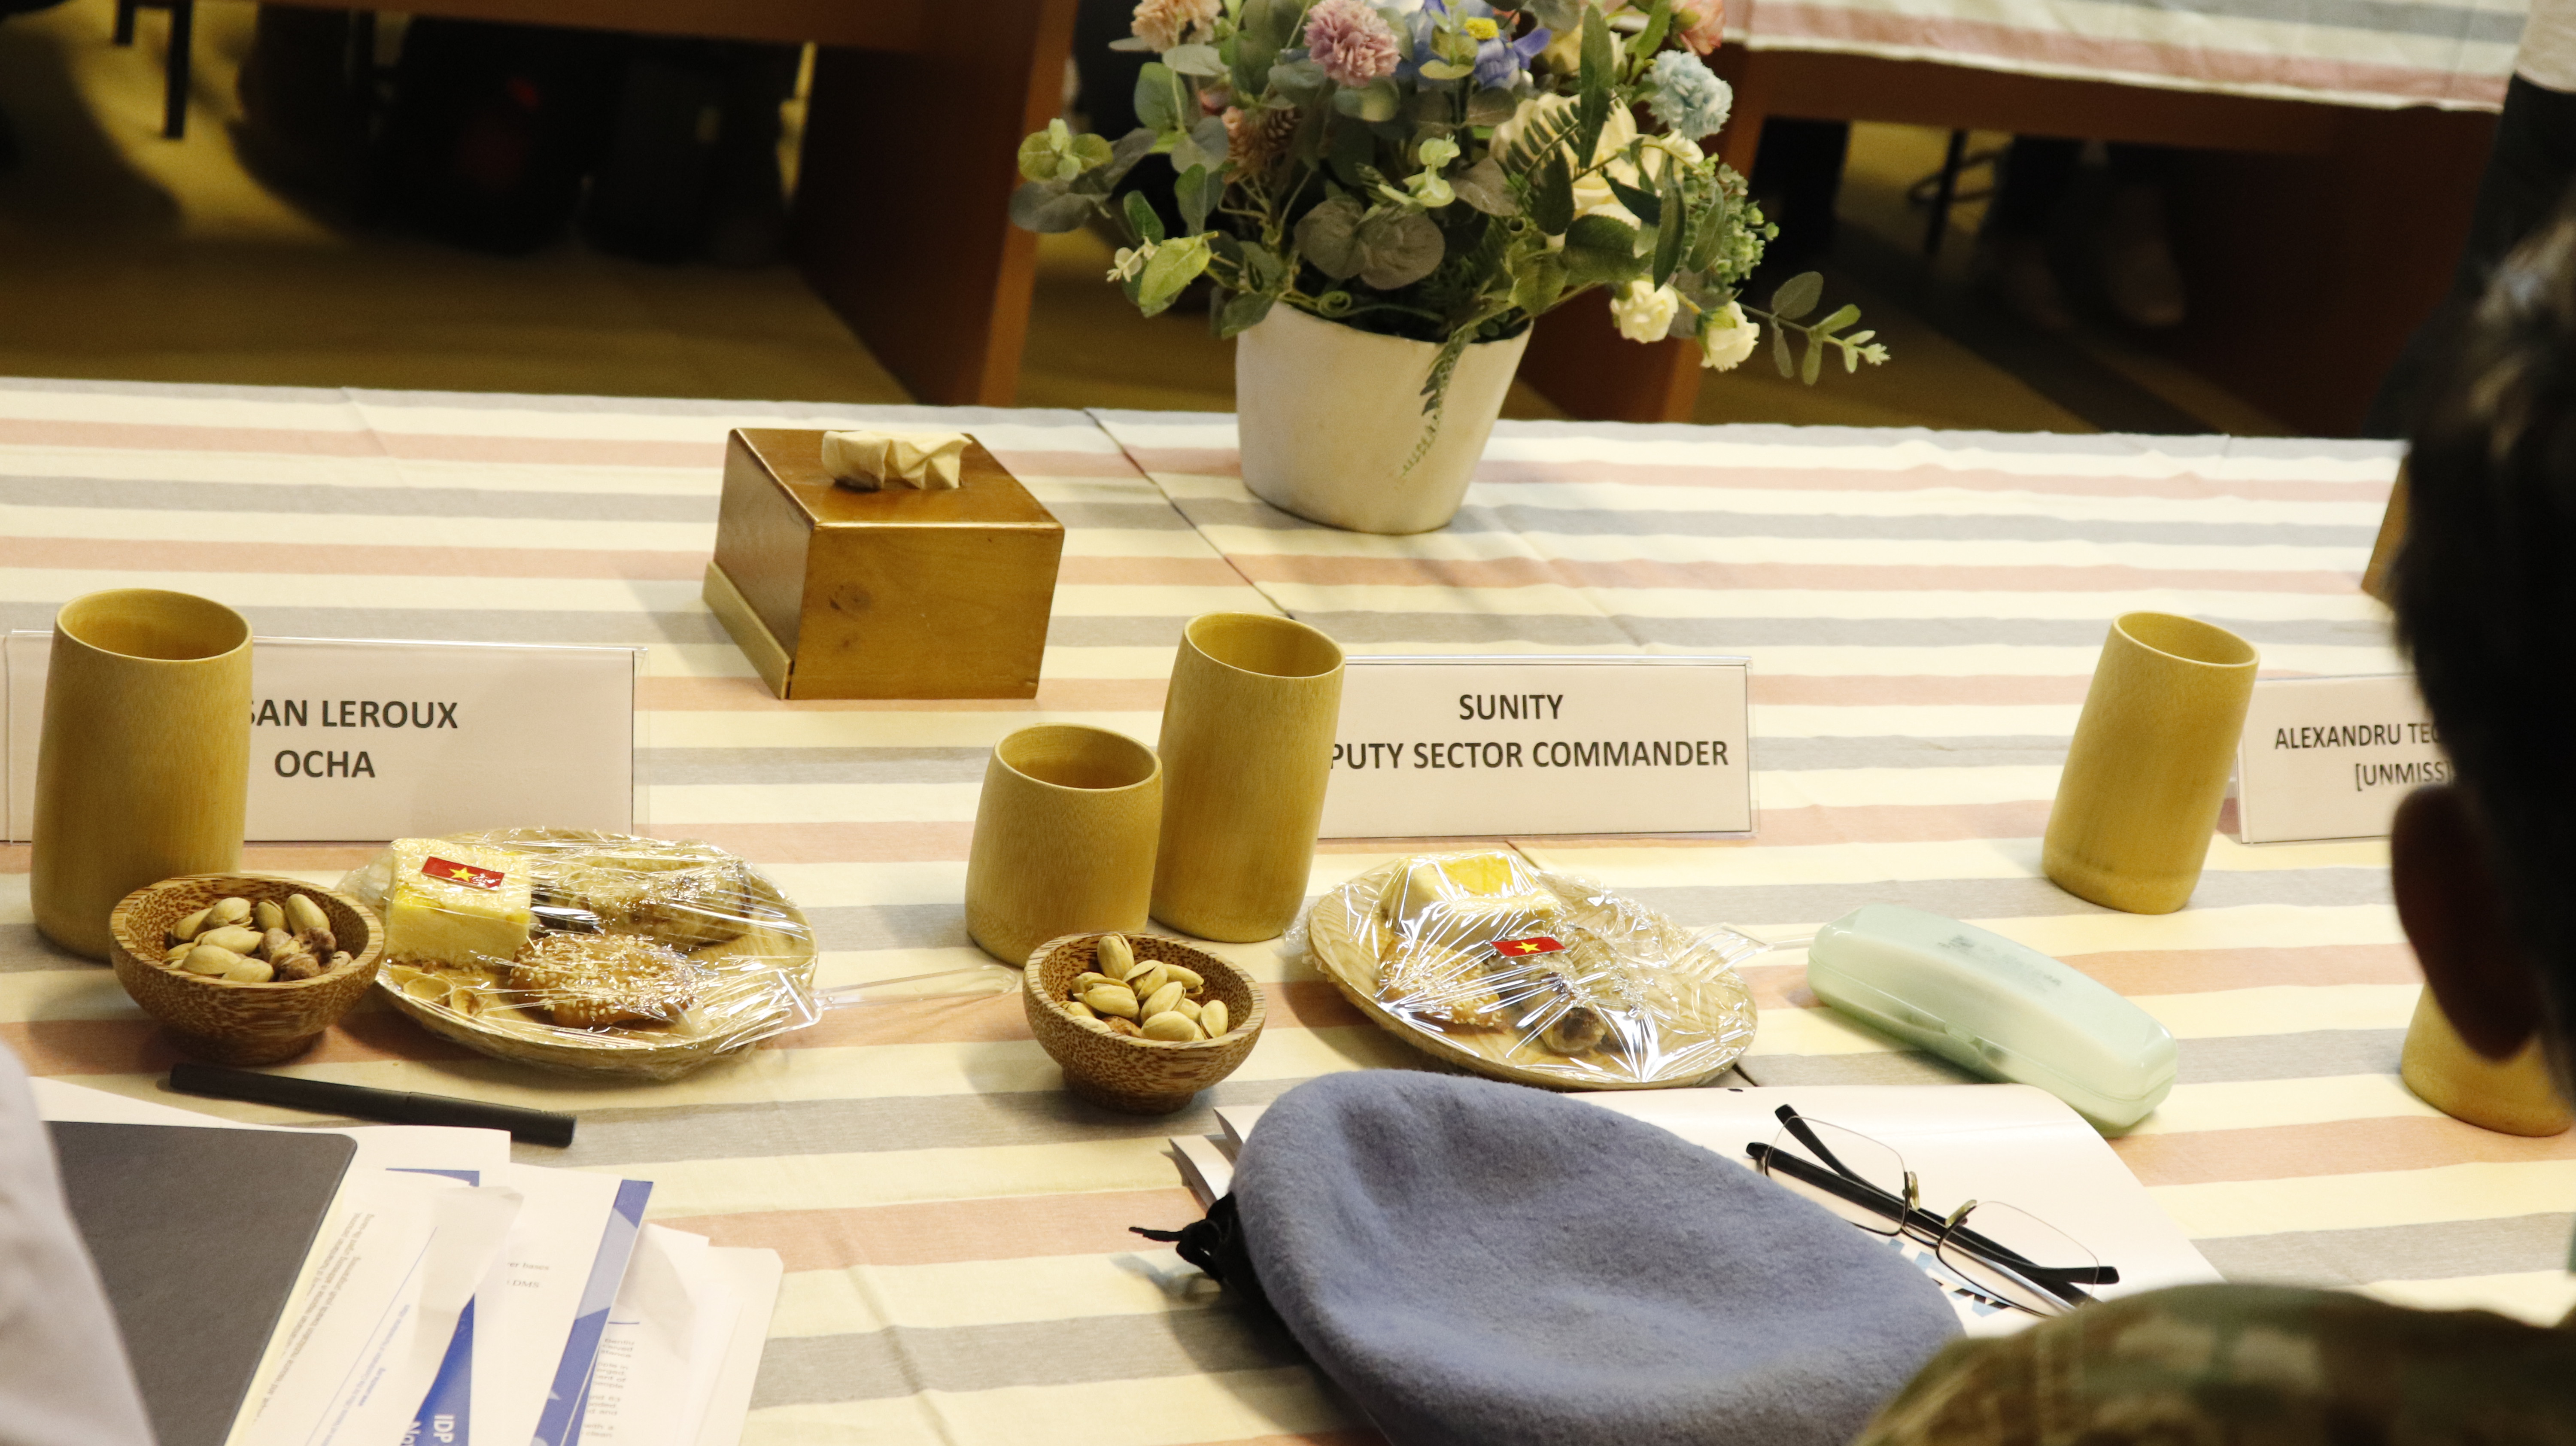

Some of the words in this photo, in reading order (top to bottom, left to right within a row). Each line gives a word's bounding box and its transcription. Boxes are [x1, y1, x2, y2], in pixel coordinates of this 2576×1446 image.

[322, 700, 458, 728] LEROUX
[1459, 694, 1564, 720] SUNITY
[2275, 724, 2400, 750] ALEXANDRU
[274, 750, 375, 778] OCHA
[1414, 742, 1523, 768] SECTOR
[1532, 741, 1729, 766] COMMANDER
[433, 1414, 453, 1443] IDP
